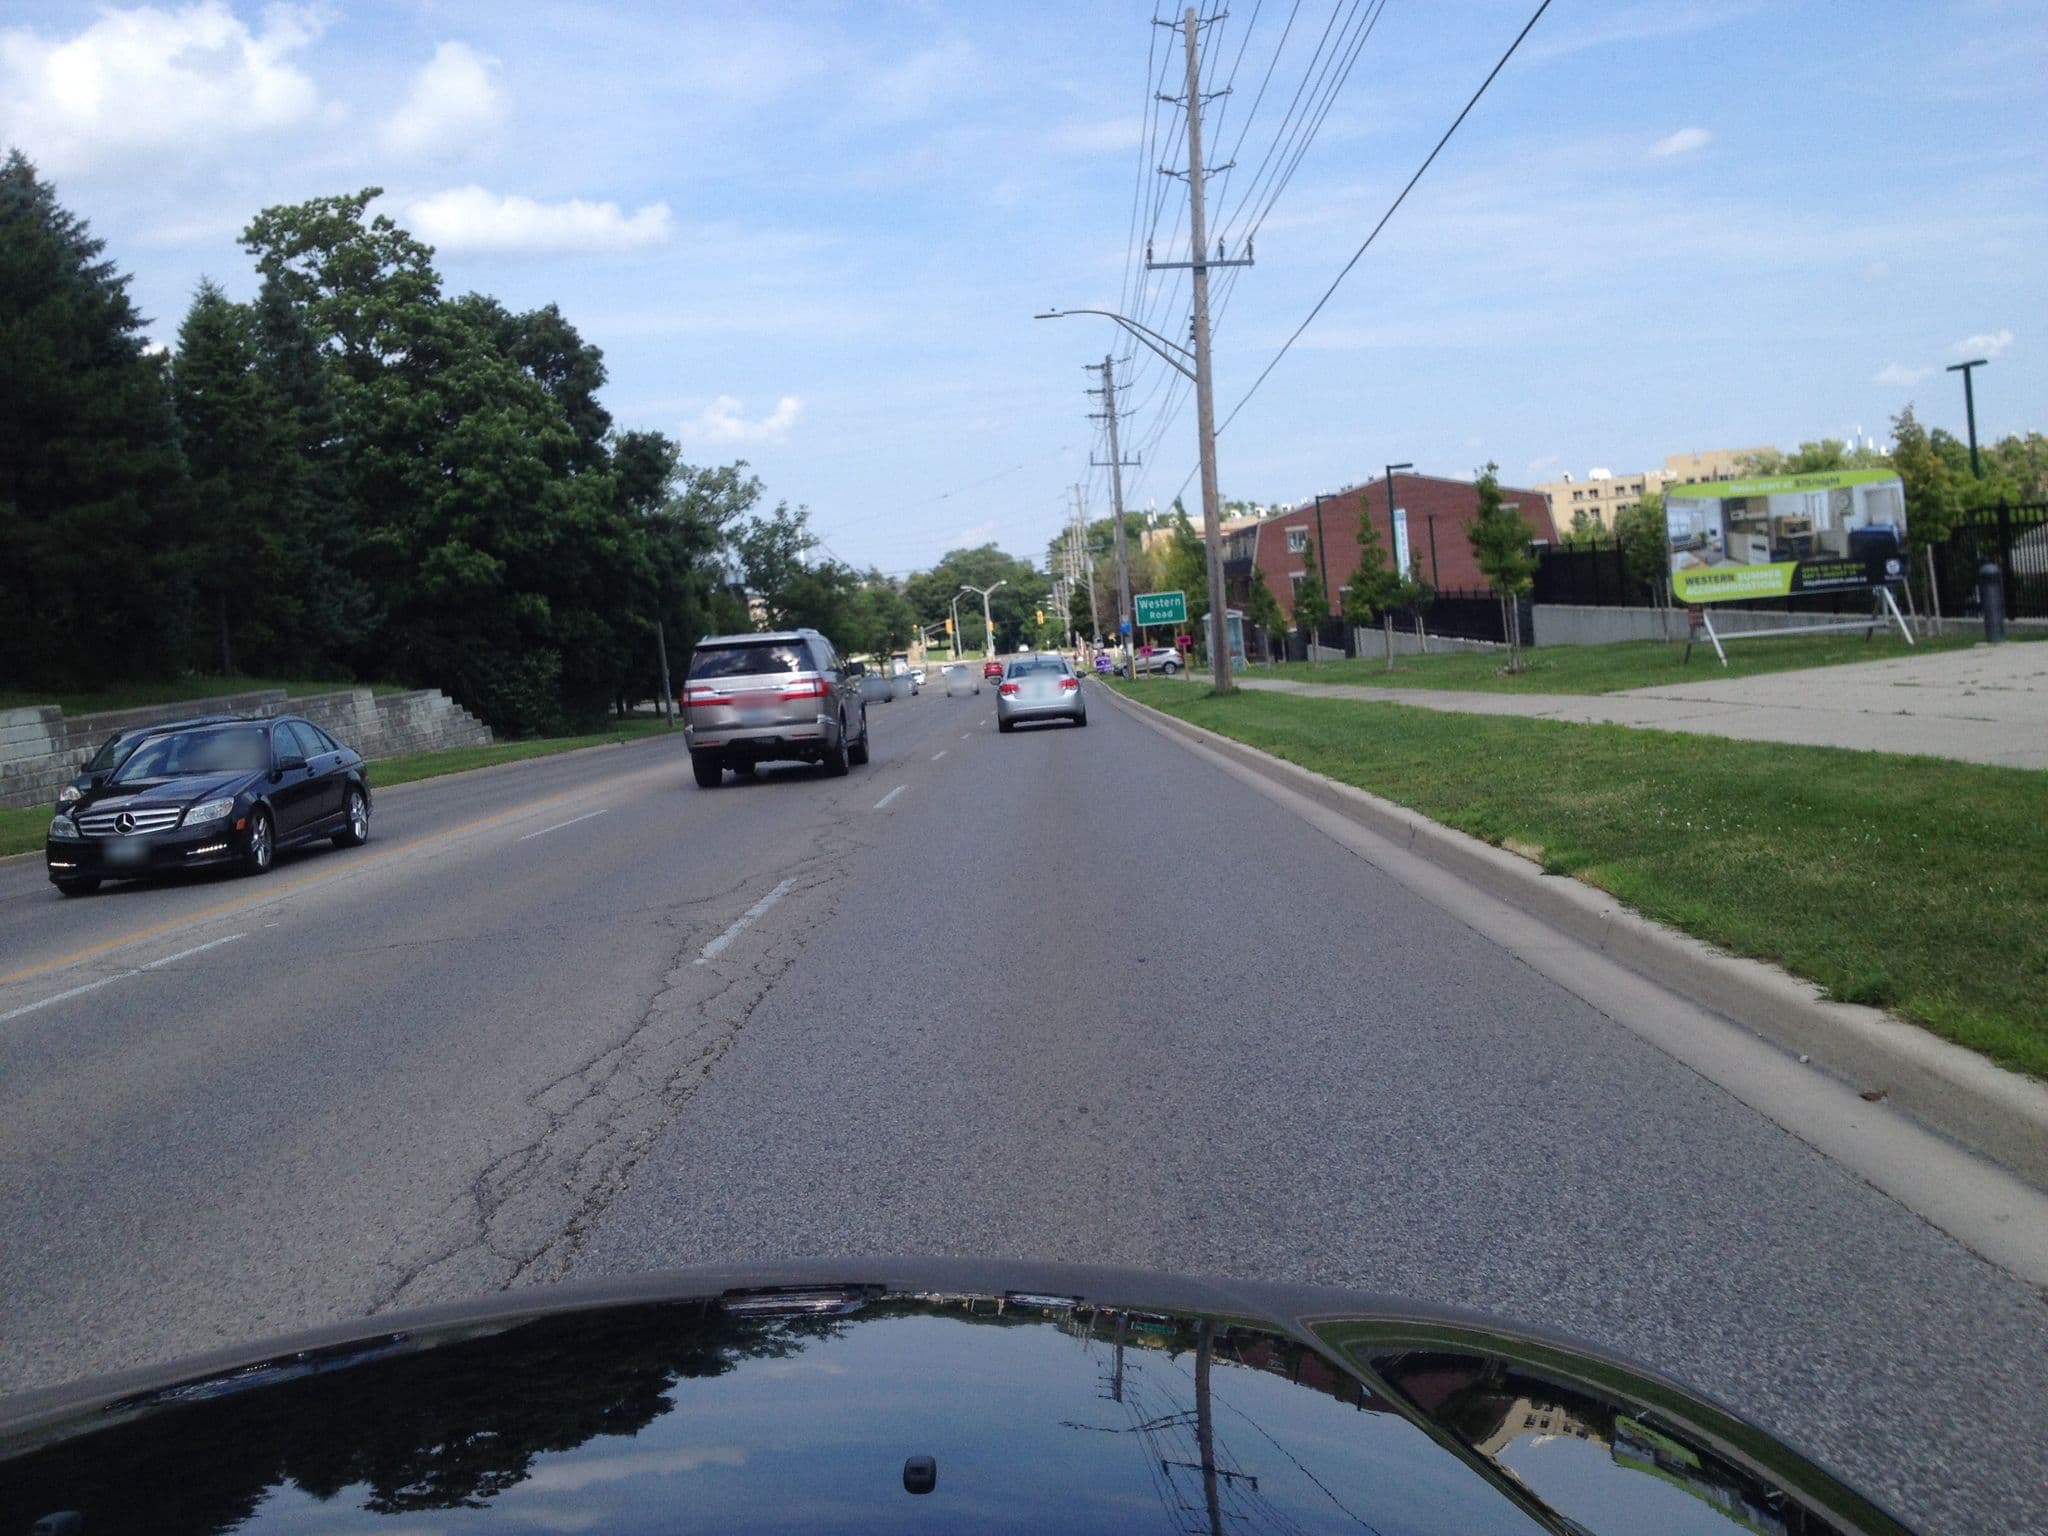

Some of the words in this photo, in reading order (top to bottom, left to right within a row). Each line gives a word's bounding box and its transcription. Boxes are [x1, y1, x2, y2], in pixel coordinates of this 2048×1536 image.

[1685, 573, 1735, 585] WESTERN
[1139, 598, 1181, 609] Western
[1149, 609, 1173, 618] Road
